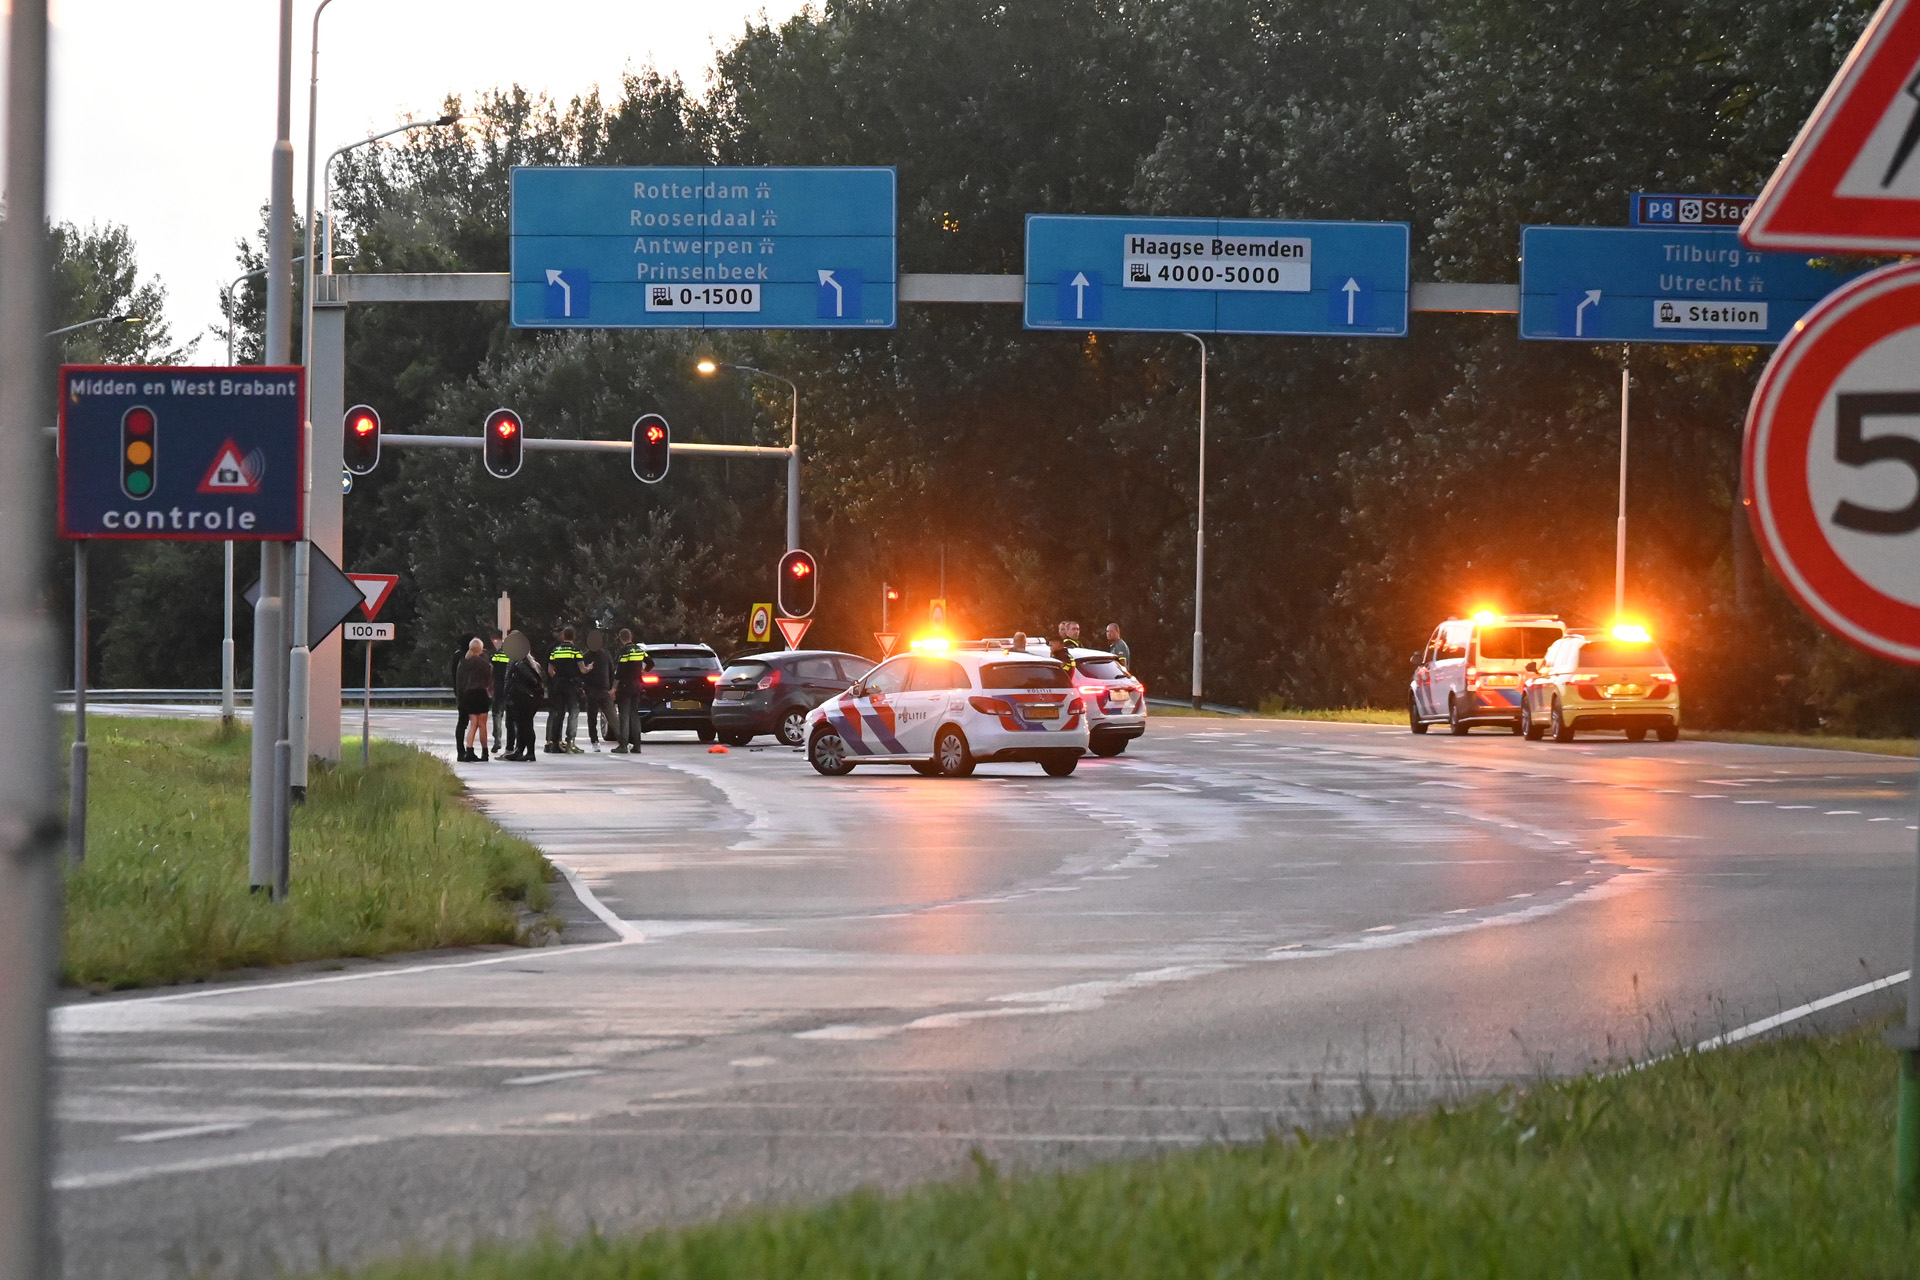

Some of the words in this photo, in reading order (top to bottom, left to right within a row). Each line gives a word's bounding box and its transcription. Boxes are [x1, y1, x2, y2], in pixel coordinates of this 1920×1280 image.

[633, 181, 749, 199] Rotterdam
[630, 209, 756, 227] Roosendaal
[1648, 202, 1674, 219] P8
[633, 237, 753, 258] Antwerpen
[1130, 237, 1204, 259] Haagse
[1211, 238, 1304, 259] Beemden
[1663, 244, 1740, 268] Tilburg
[636, 262, 768, 280] Prinsenbeek
[1157, 264, 1280, 284] 4000-5000
[1659, 274, 1742, 292] Utrecht
[679, 287, 754, 305] 0-1500
[1688, 306, 1760, 323] Station
[70, 379, 137, 396] Midden
[142, 382, 165, 395] en
[171, 379, 215, 395] West
[220, 379, 296, 396] Brabant
[102, 506, 257, 530] controle
[351, 625, 372, 638] 100
[376, 628, 387, 638] m
